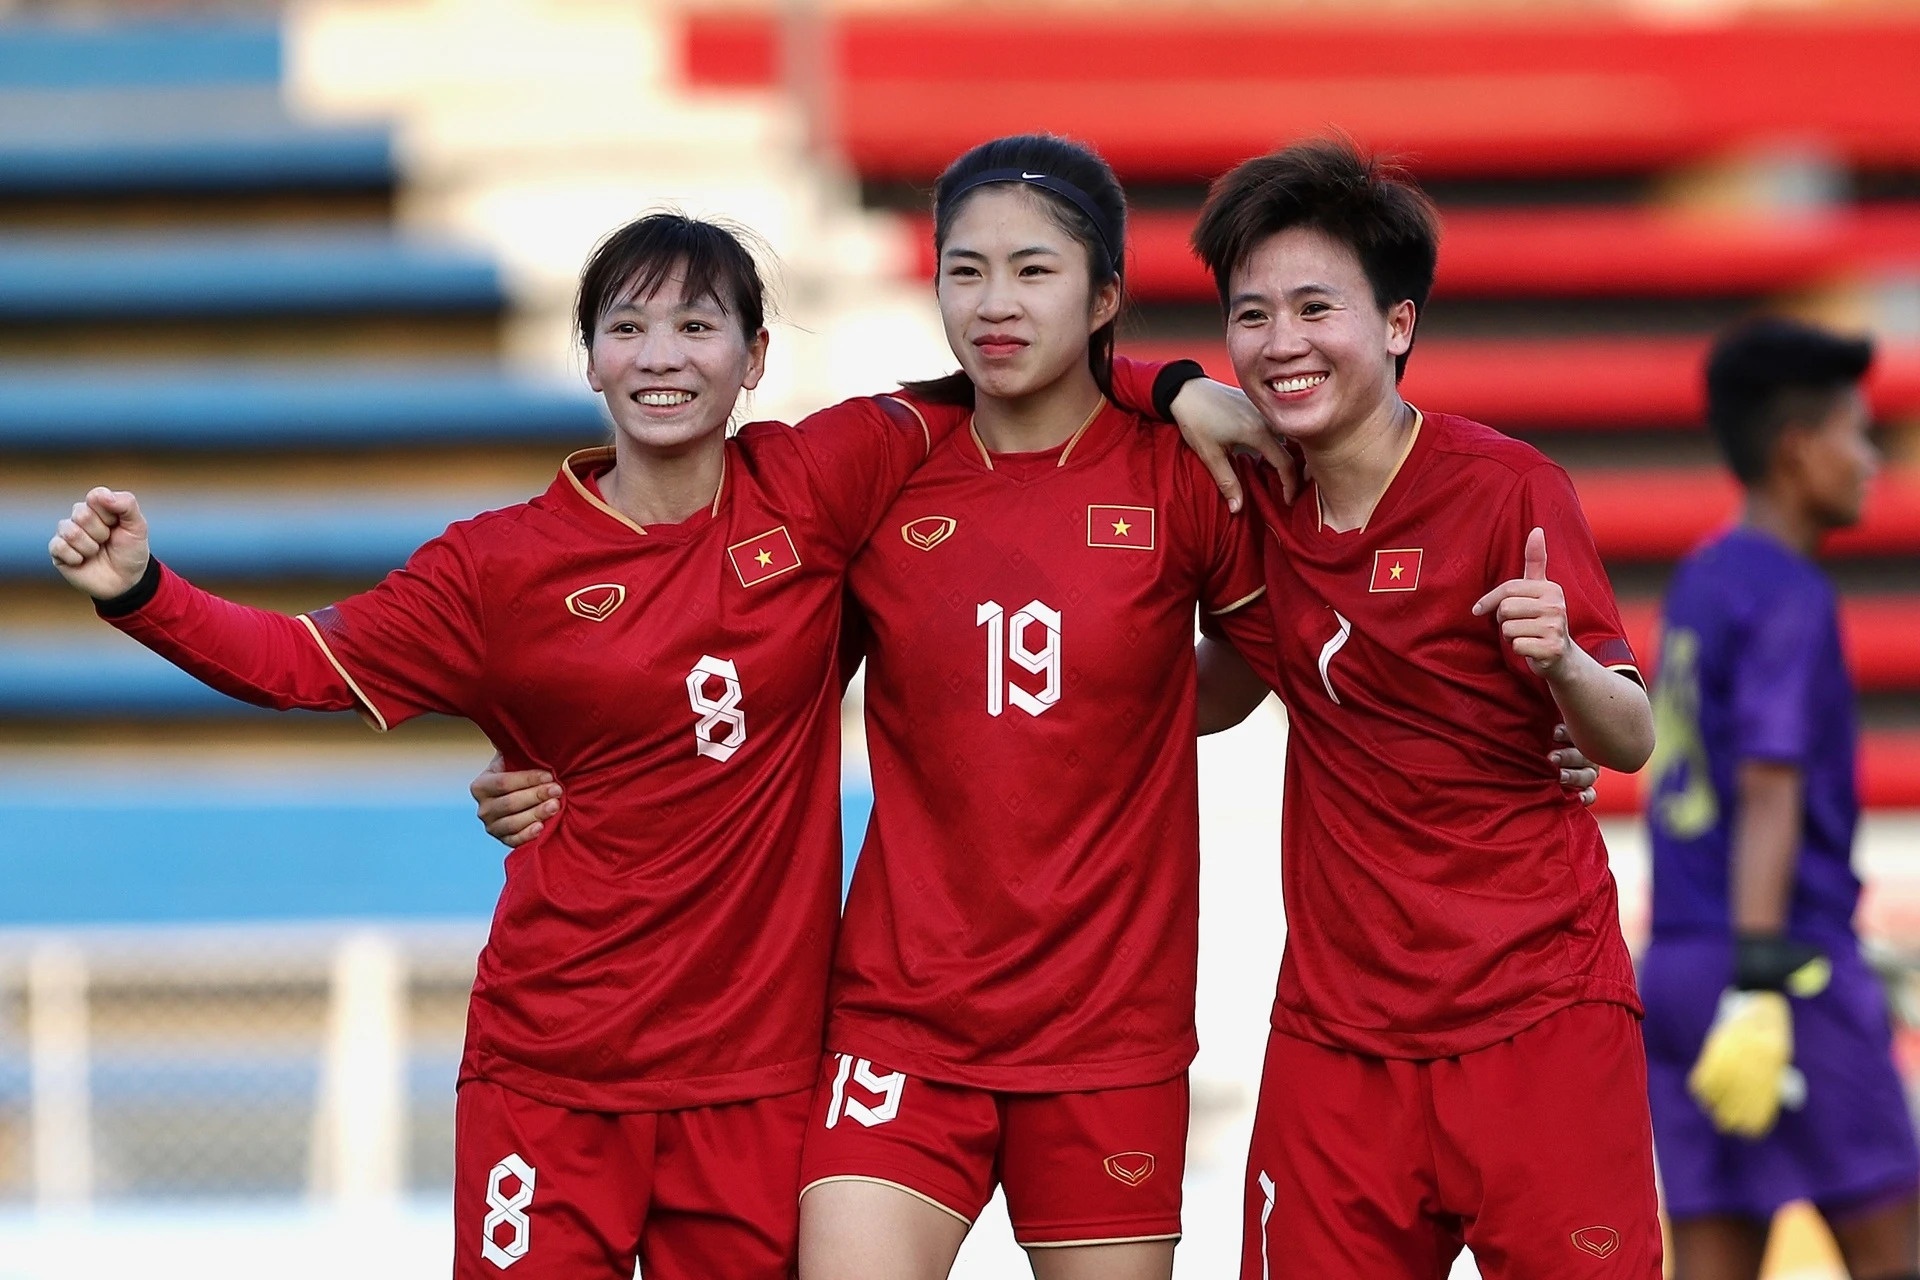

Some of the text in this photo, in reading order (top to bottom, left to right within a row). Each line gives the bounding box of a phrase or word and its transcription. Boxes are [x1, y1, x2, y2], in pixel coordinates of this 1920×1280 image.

[685, 654, 747, 763] 8
[976, 599, 1062, 717] 19
[481, 1152, 536, 1270] 8
